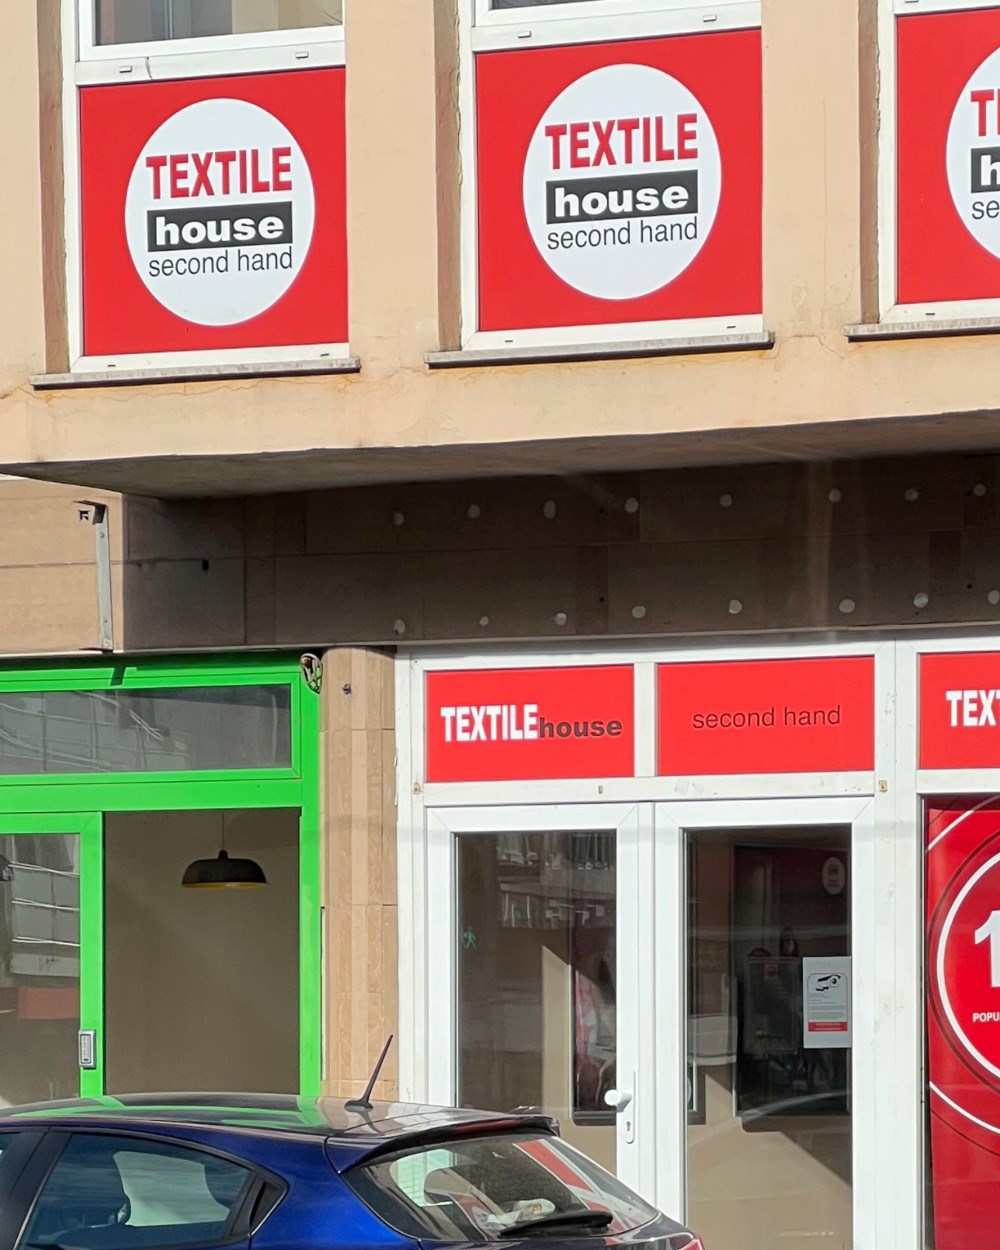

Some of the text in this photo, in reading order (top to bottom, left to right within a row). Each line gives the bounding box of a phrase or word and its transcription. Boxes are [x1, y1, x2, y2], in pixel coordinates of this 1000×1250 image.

[545, 113, 698, 170] TEXTILE
[146, 146, 292, 199] TEXTILE
[555, 180, 689, 216] house
[155, 213, 284, 245] house
[547, 215, 698, 250] second hand
[148, 245, 293, 278] second hand
[693, 705, 841, 729] second hand
